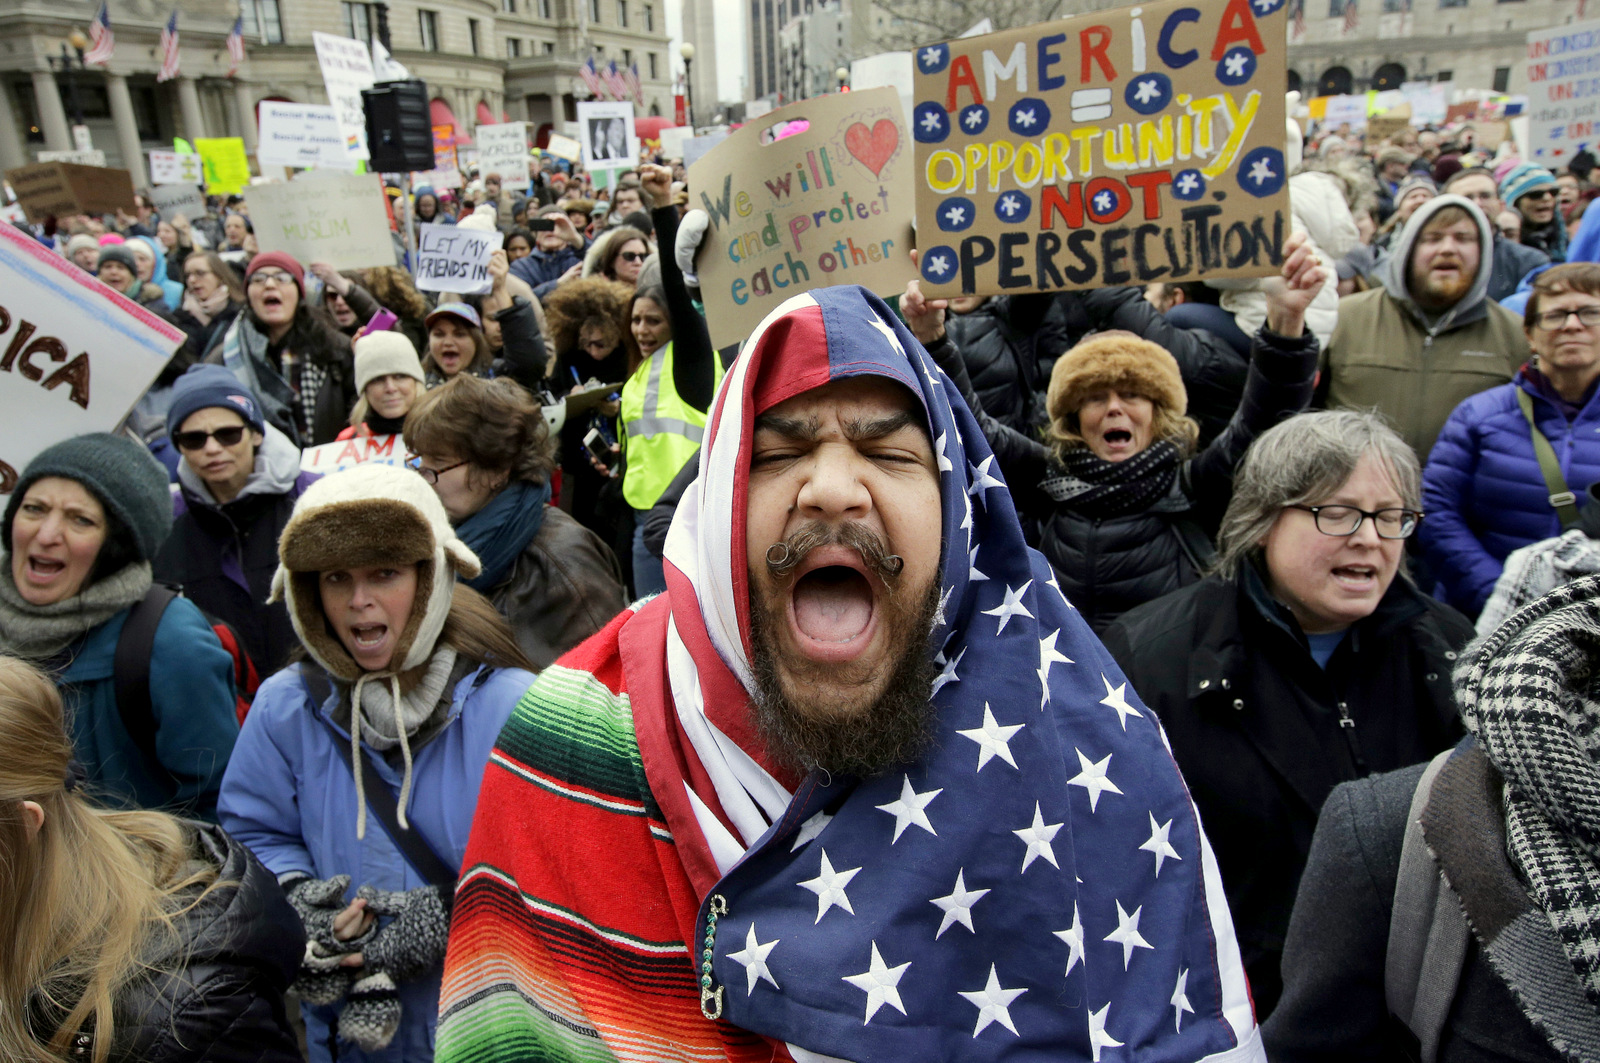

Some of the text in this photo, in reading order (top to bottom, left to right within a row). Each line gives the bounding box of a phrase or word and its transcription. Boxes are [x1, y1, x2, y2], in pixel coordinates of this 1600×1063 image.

[700, 147, 835, 232] We will
[1040, 169, 1174, 231] NOT
[282, 217, 351, 241] MUSLIM
[422, 231, 489, 260] LET MY
[728, 185, 889, 263] and protect
[418, 257, 488, 281] FRIENDS IN
[731, 238, 894, 305] each other
[312, 449, 321, 467] I
[335, 434, 396, 465] AM
